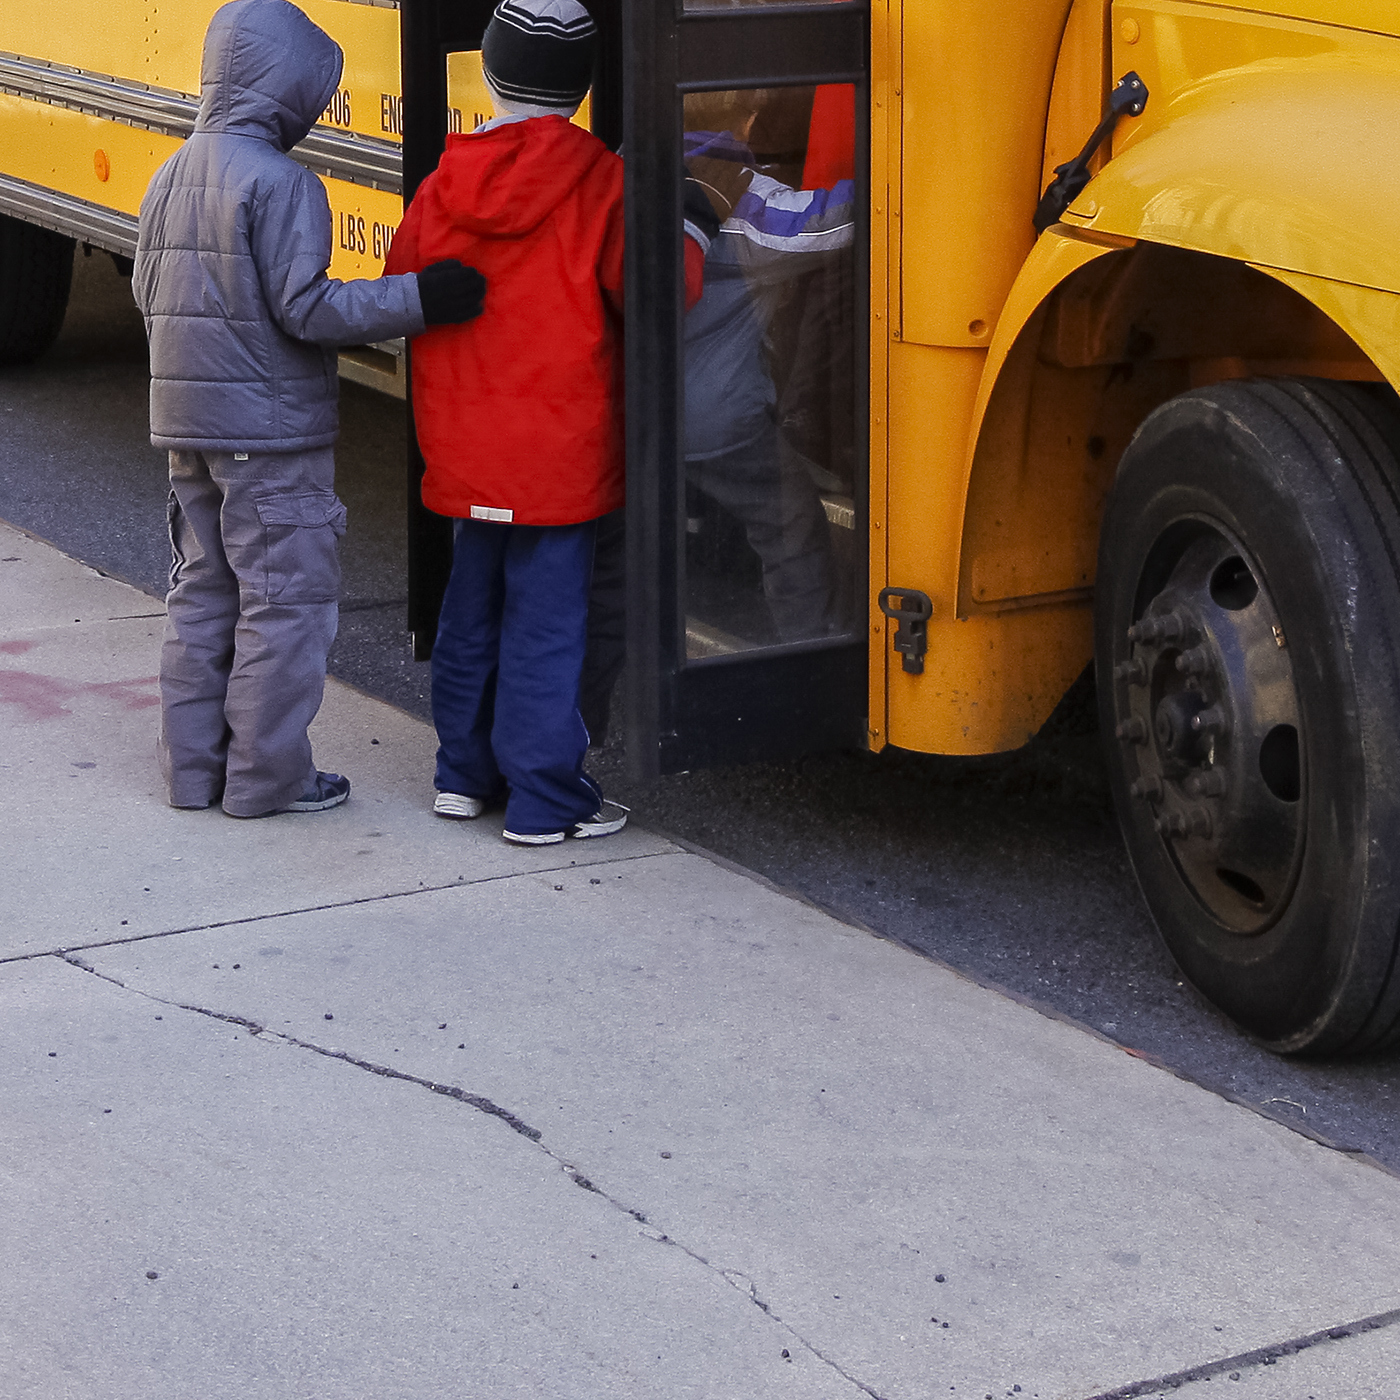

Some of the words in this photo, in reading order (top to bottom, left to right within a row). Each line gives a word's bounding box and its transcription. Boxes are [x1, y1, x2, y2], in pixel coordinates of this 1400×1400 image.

[321, 89, 350, 128] 406
[340, 212, 366, 255] LBS
[373, 221, 397, 260] GV
